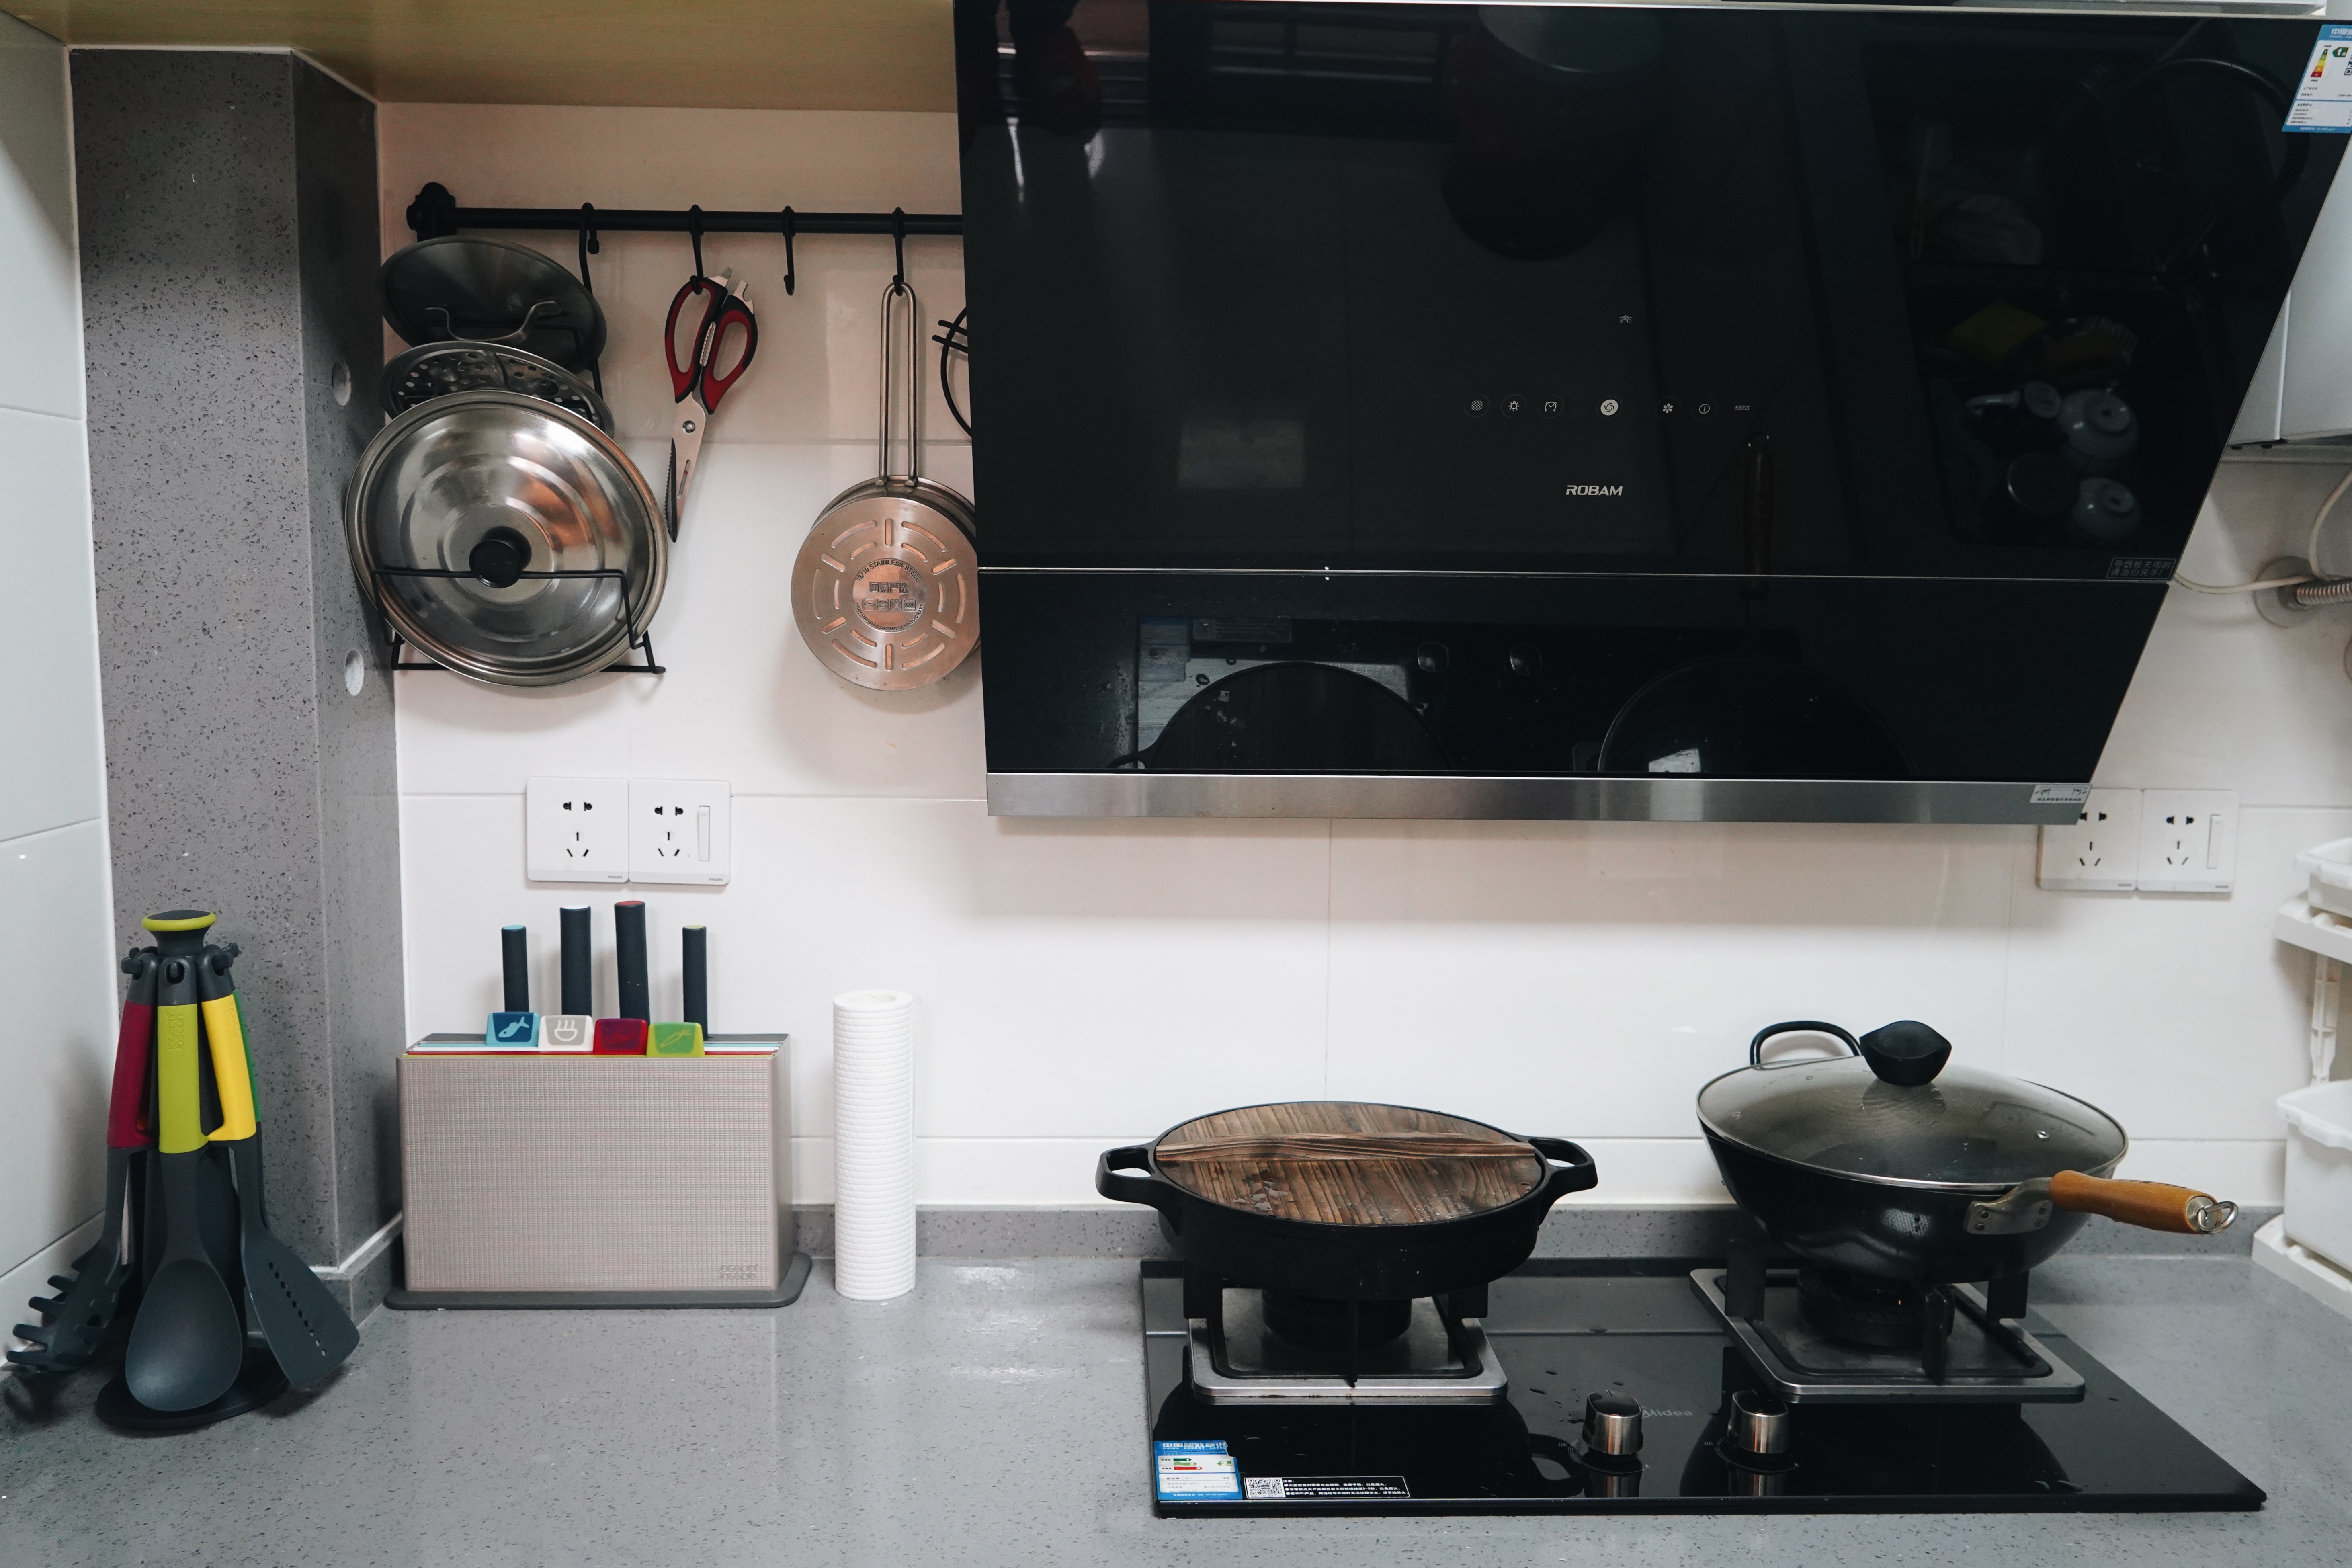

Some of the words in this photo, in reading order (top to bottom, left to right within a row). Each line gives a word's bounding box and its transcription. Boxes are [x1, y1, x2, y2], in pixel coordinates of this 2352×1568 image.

[1566, 485, 1623, 496] ROBAM
[856, 567, 869, 581] 18/10
[869, 560, 904, 569] STAINLESS
[905, 566, 920, 582] STEEL
[869, 582, 909, 593] 网易严选
[854, 603, 863, 615] HIGH
[861, 614, 879, 629] QUALITY
[904, 604, 924, 627] HANDICRAFT
[1641, 1407, 1693, 1418] Midea
